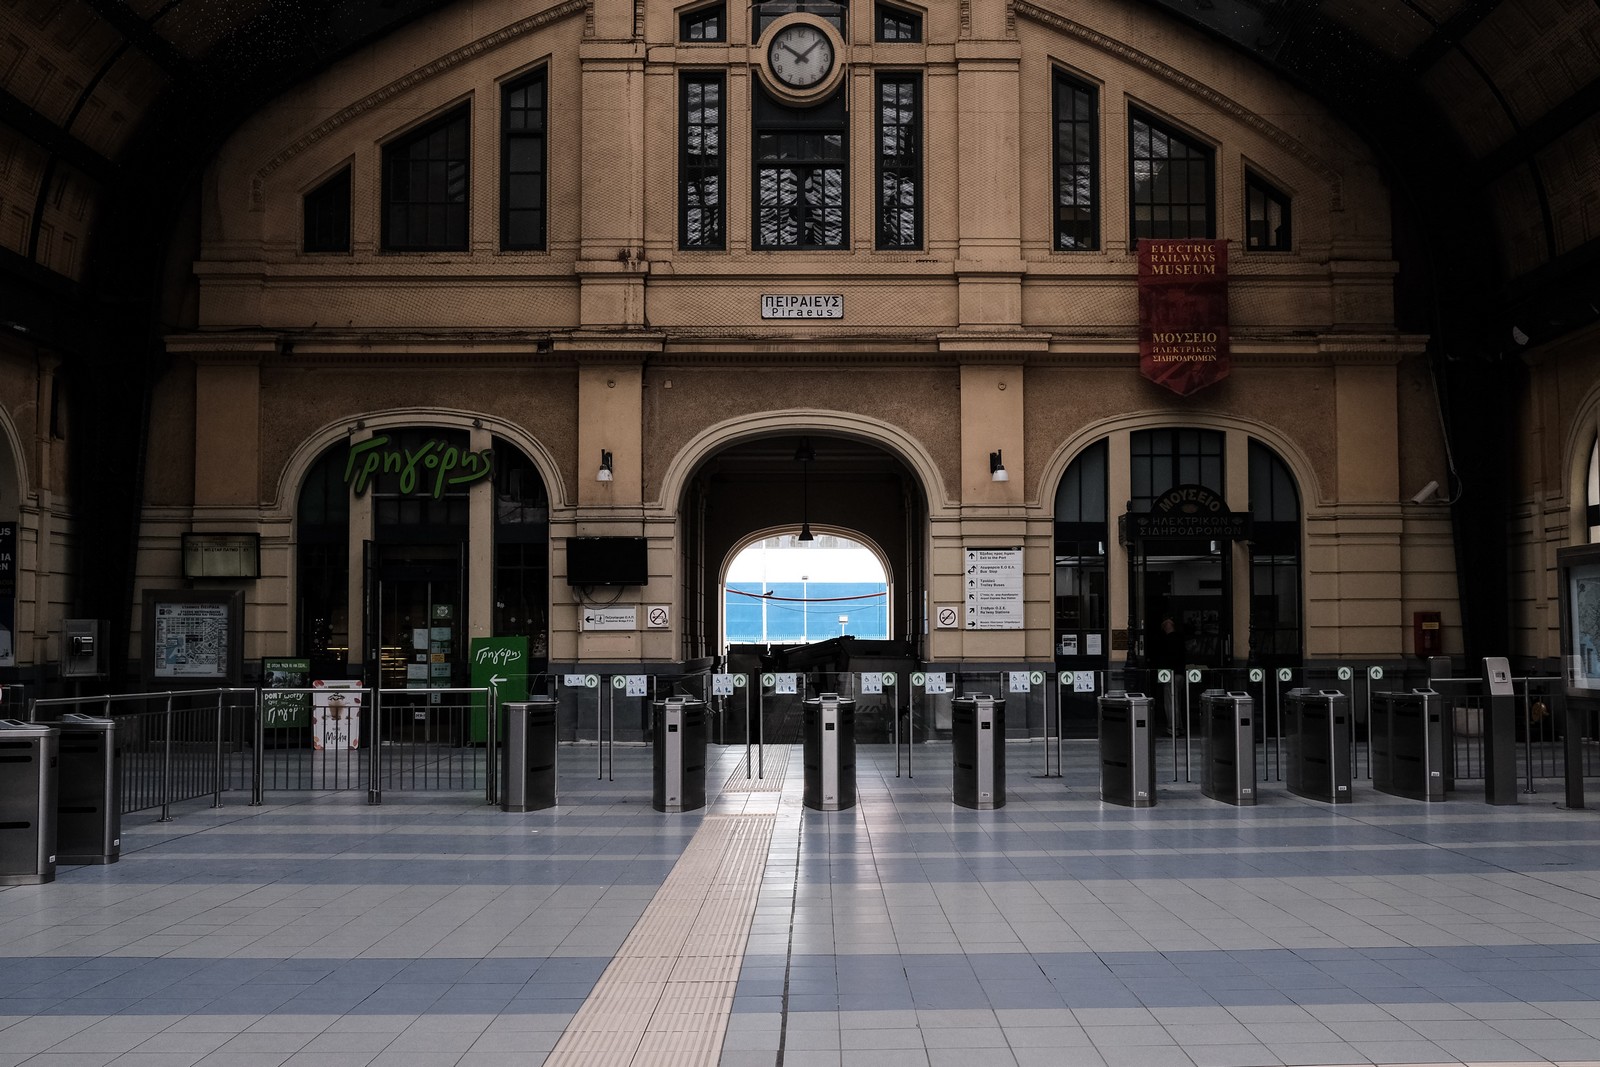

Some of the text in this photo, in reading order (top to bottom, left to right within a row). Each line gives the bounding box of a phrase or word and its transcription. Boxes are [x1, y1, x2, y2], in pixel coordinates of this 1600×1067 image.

[773, 53, 780, 62] 9
[823, 53, 829, 62] 3
[777, 65, 783, 74] 8
[1151, 244, 1216, 253] ELECTRIC
[1151, 254, 1216, 263] RAILWAYS
[1151, 264, 1216, 275] MUSEUM
[765, 296, 840, 307] ΠΕΙΡΑΙΕΥΣ
[772, 307, 833, 317] Piraeus
[1152, 332, 1217, 343] ΜΟΥΣΕΙΟ
[1152, 345, 1217, 353] ΗΛΕΚΤΡΙΚΩΝ
[1152, 354, 1217, 362] ΣΙΔΗΡΟΔΡΟΜΩΝ
[343, 436, 493, 500] Γρηγόρης
[1158, 489, 1221, 512] ΜΟΥΣΕΙΟ
[1151, 516, 1229, 526] ΗΛΕΚΤΡΙΚΩΝ
[1139, 526, 1242, 536] ΣΙΔΗΡΟΔΡΟΜΩΝ
[475, 645, 522, 667] Γρηγόρης
